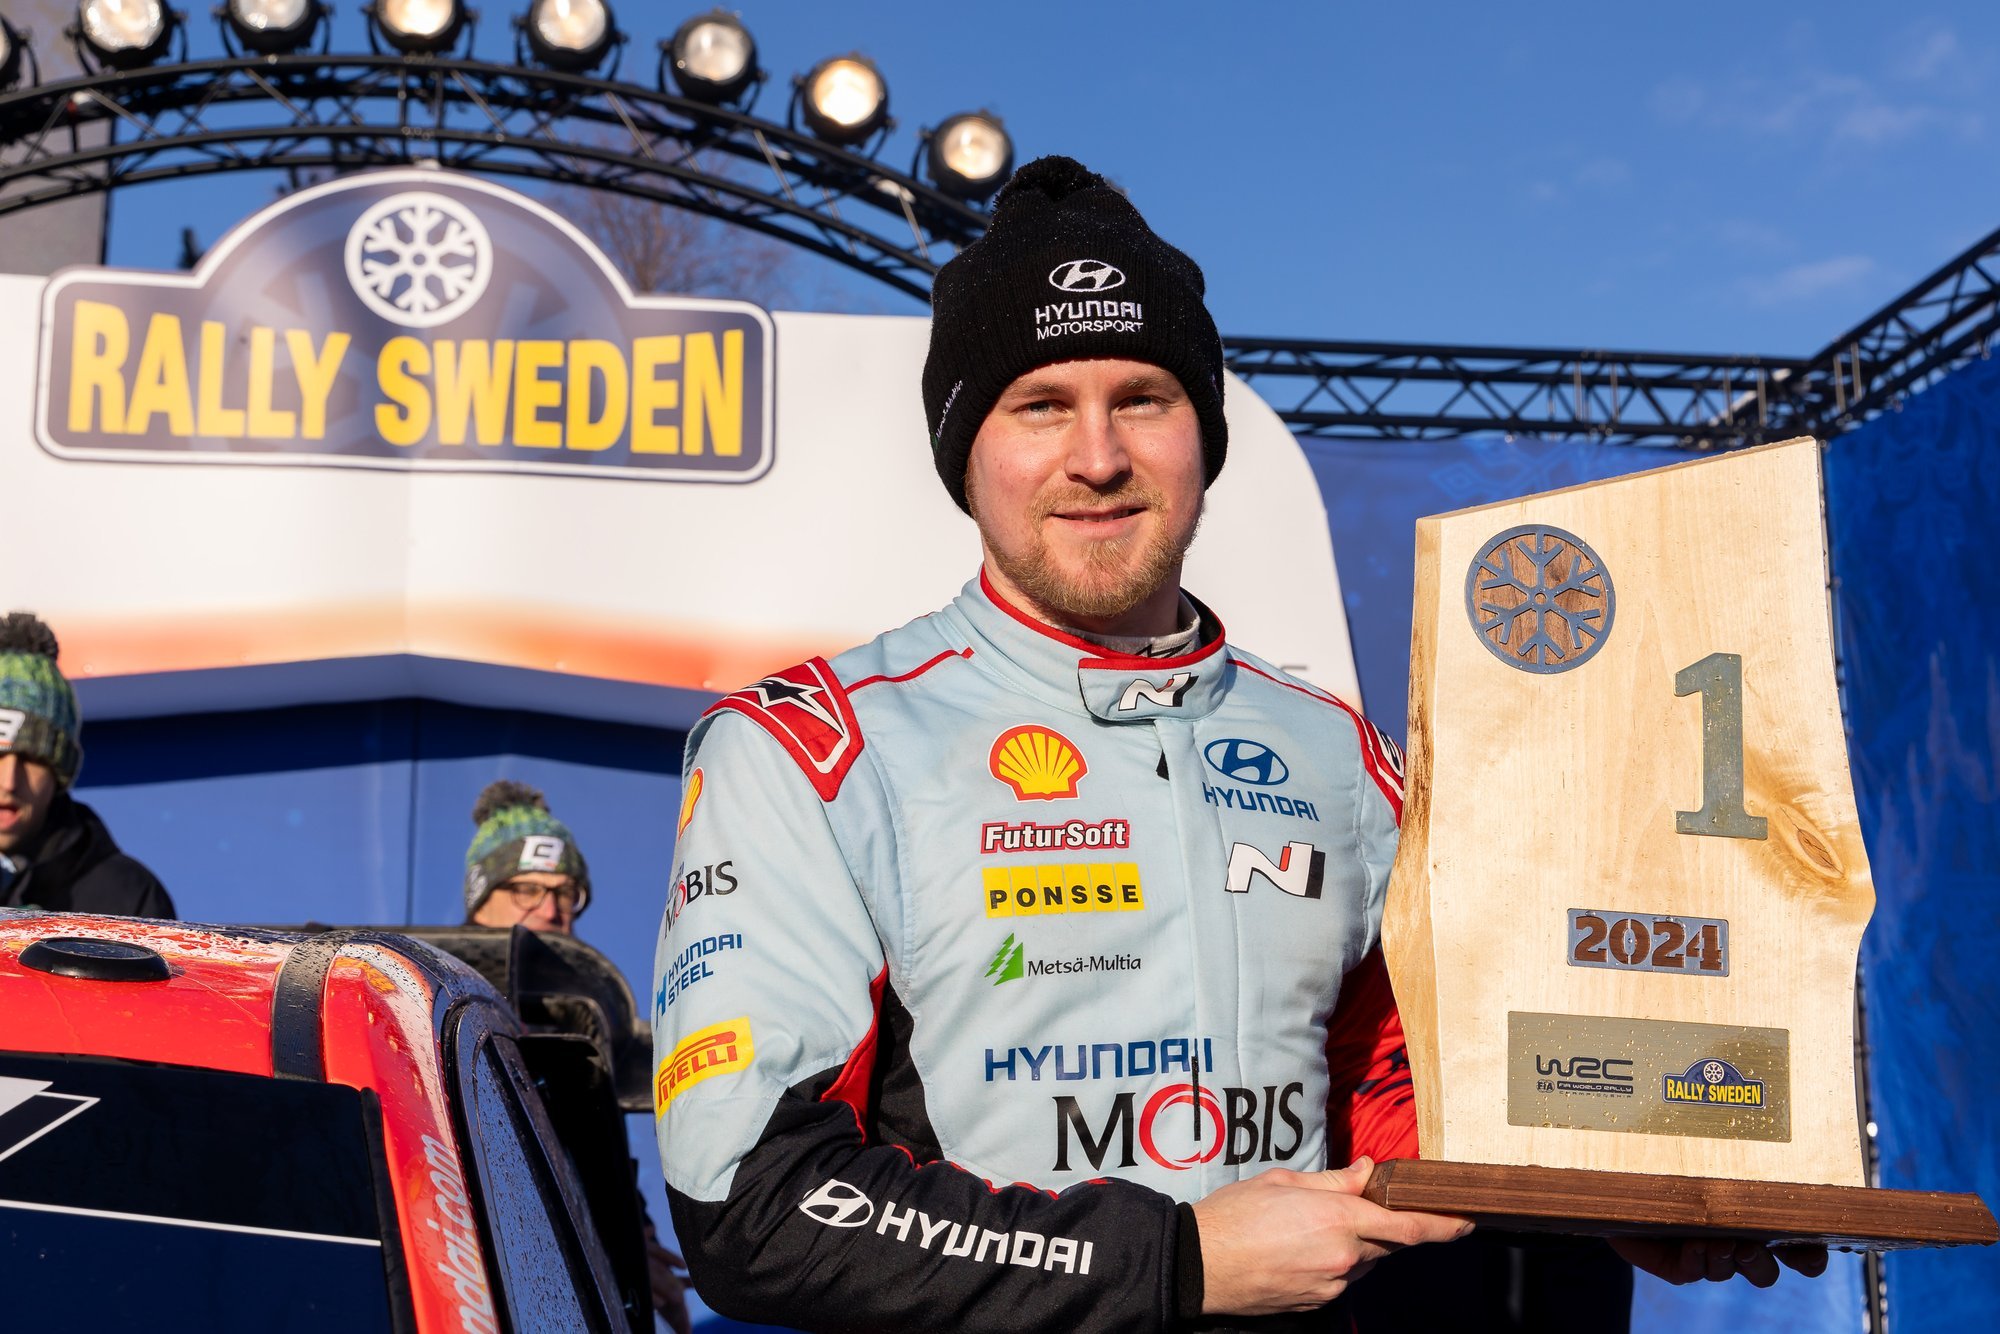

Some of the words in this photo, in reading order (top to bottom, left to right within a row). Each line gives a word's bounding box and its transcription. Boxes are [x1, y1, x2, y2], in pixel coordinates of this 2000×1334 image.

[1035, 300, 1142, 324] HYUNDAI
[1036, 320, 1143, 340] MOTORSPORT
[67, 300, 351, 439] RALLY
[374, 329, 745, 456] SWEDEN
[1674, 652, 1768, 840] 1
[1202, 780, 1320, 822] HYUNDAI
[983, 820, 1128, 851] FuturSoft
[664, 860, 738, 939] MOBIS
[990, 884, 1139, 910] PONSSE
[668, 934, 743, 985] HYUNDAI
[1027, 954, 1141, 976] Metsä-Multia
[1574, 915, 1723, 971] 2024
[668, 961, 713, 1006] STEEL
[658, 1030, 738, 1109] PIRELLI
[985, 1037, 1213, 1081] HYUNDAI
[1536, 1054, 1633, 1081] WRC
[1667, 1079, 1706, 1100] RALLY
[1708, 1083, 1760, 1104] SWEDEN
[1052, 1082, 1304, 1171] MOBIS
[876, 1201, 1094, 1275] HYUNDAI
